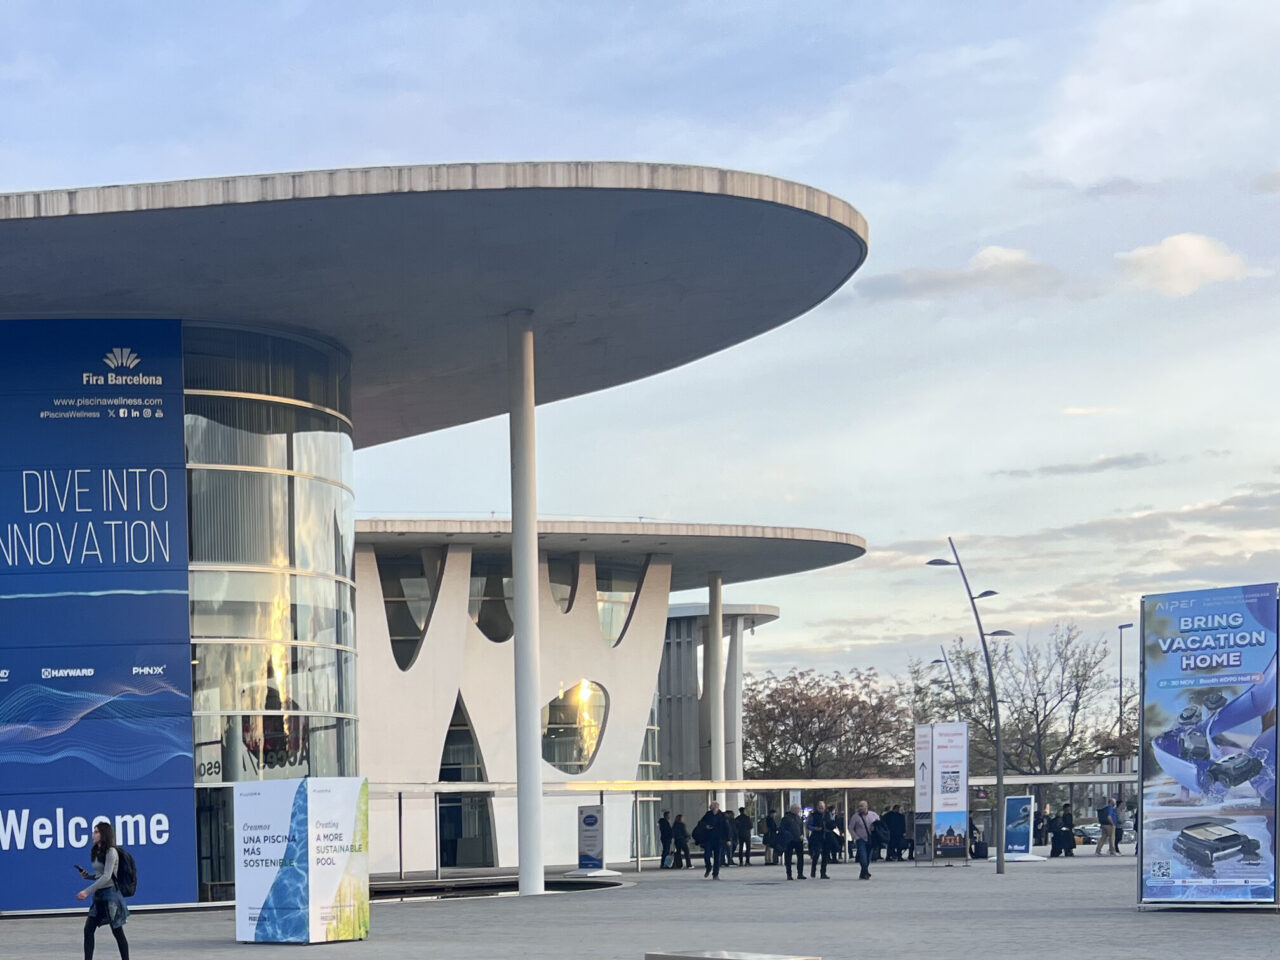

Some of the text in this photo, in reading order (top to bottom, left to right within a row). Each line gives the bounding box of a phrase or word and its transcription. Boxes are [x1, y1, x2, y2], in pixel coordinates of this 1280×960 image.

[82, 372, 163, 385] Fira Barcelona
[53, 396, 163, 407] www.piscinawellness.com
[22, 468, 168, 513] DIVE INTO
[1180, 613, 1243, 632] BRING
[1158, 631, 1266, 653] VACATION
[1181, 652, 1242, 670] HOME
[51, 668, 94, 677] HAYWARD
[243, 834, 297, 844] UNA PISCINA
[316, 832, 343, 842] A MORE
[243, 846, 261, 856] MÁS
[316, 843, 363, 854] SUSTAINABLE
[243, 858, 295, 868] SOSTENIBLE
[316, 857, 336, 866] POOL
